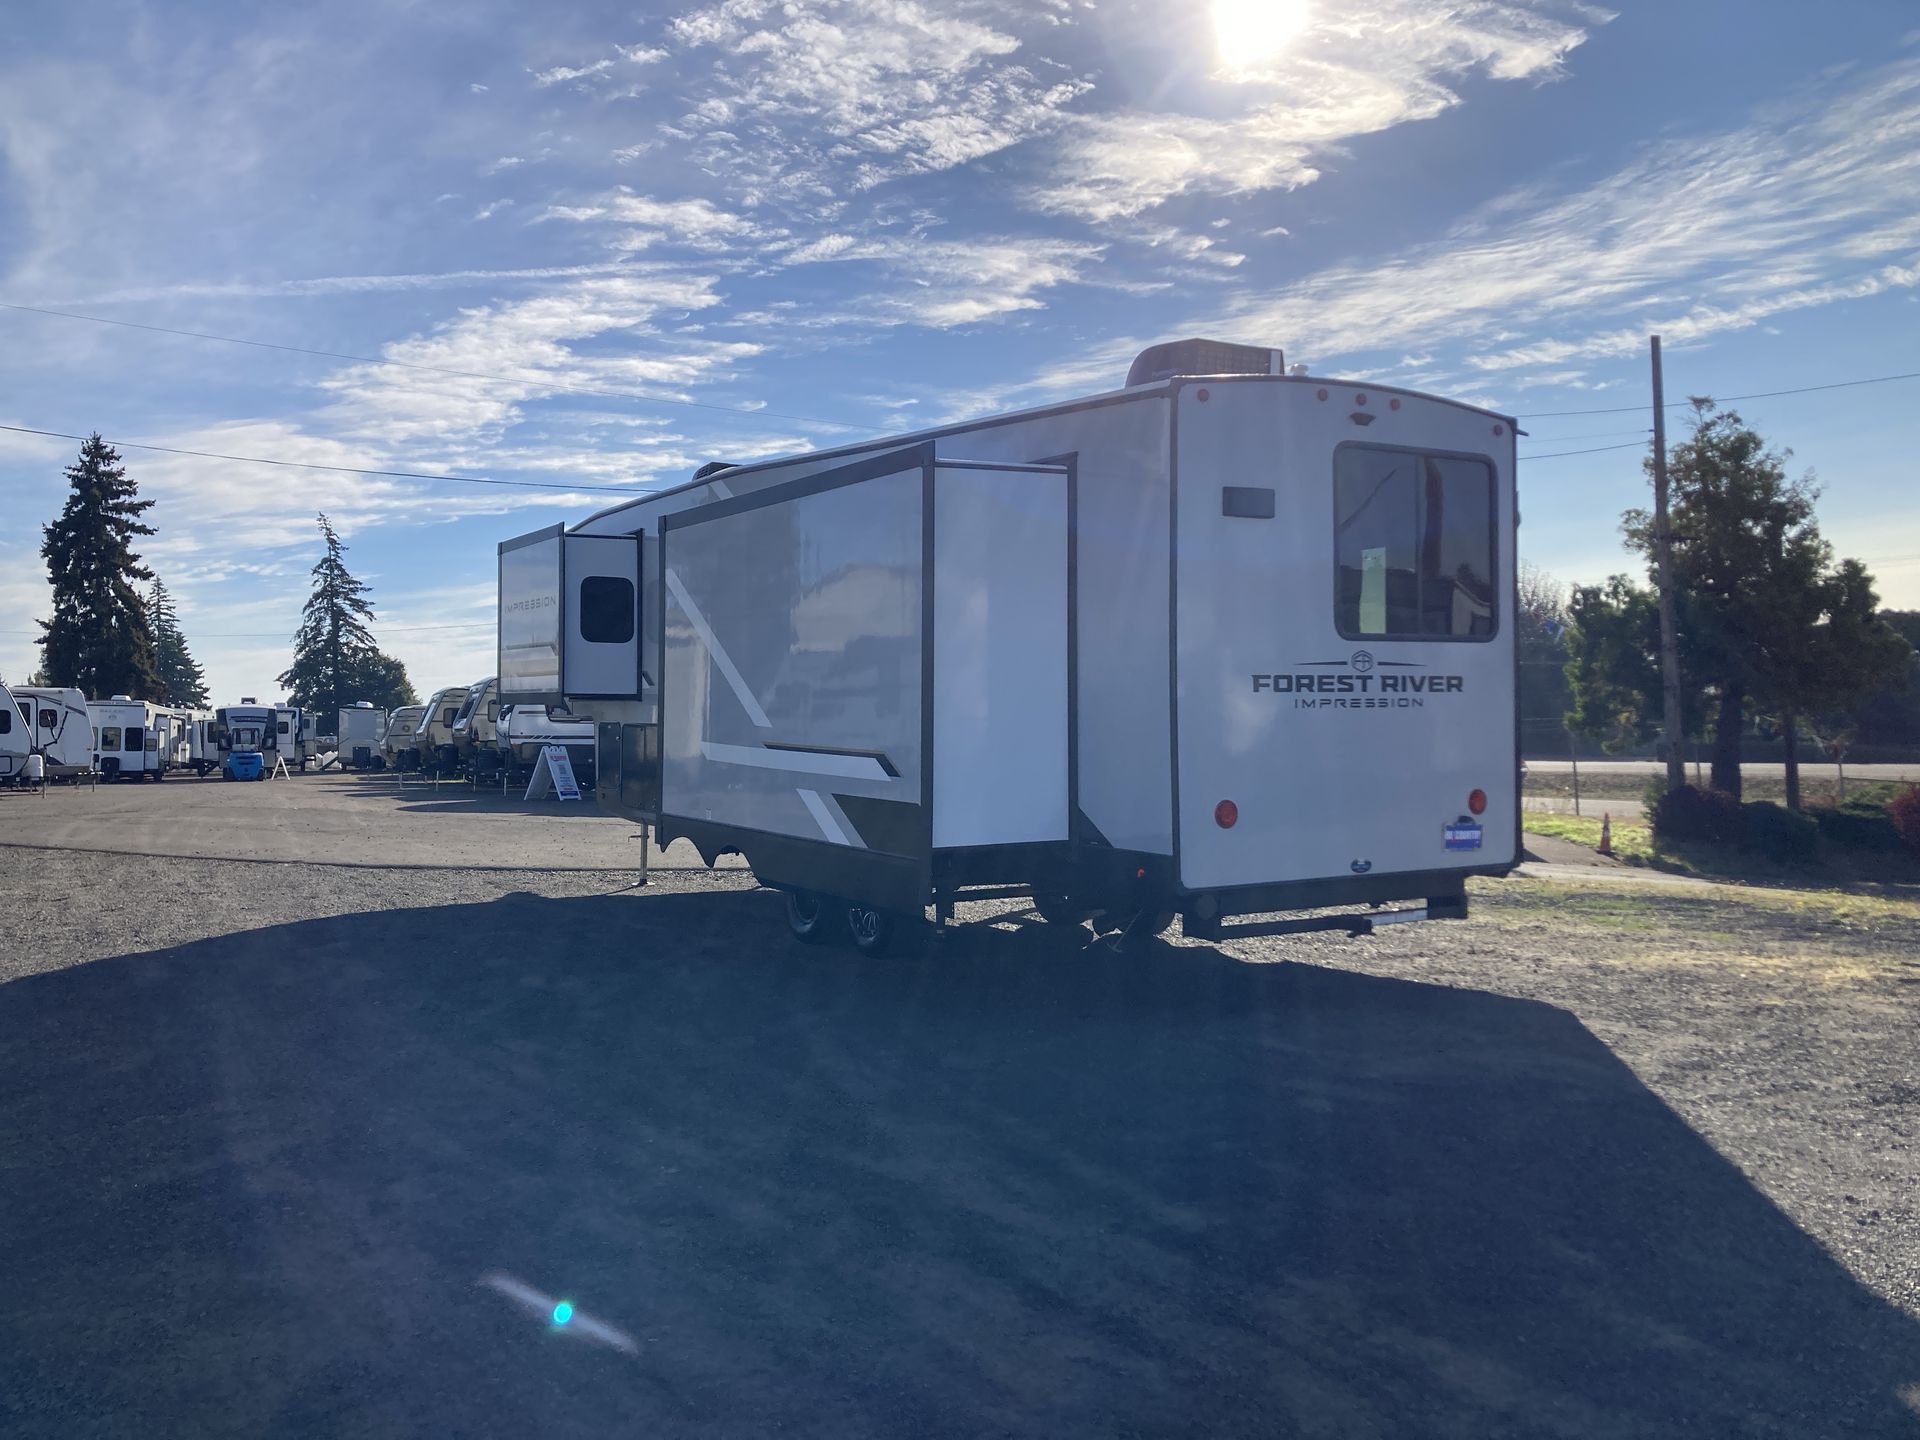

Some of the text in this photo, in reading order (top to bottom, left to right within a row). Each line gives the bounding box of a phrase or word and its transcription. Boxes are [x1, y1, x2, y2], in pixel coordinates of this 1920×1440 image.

[504, 595, 557, 614] IMPRESSION
[1251, 674, 1464, 693] FOREST RIVER
[1294, 698, 1424, 709] IMPRESSION
